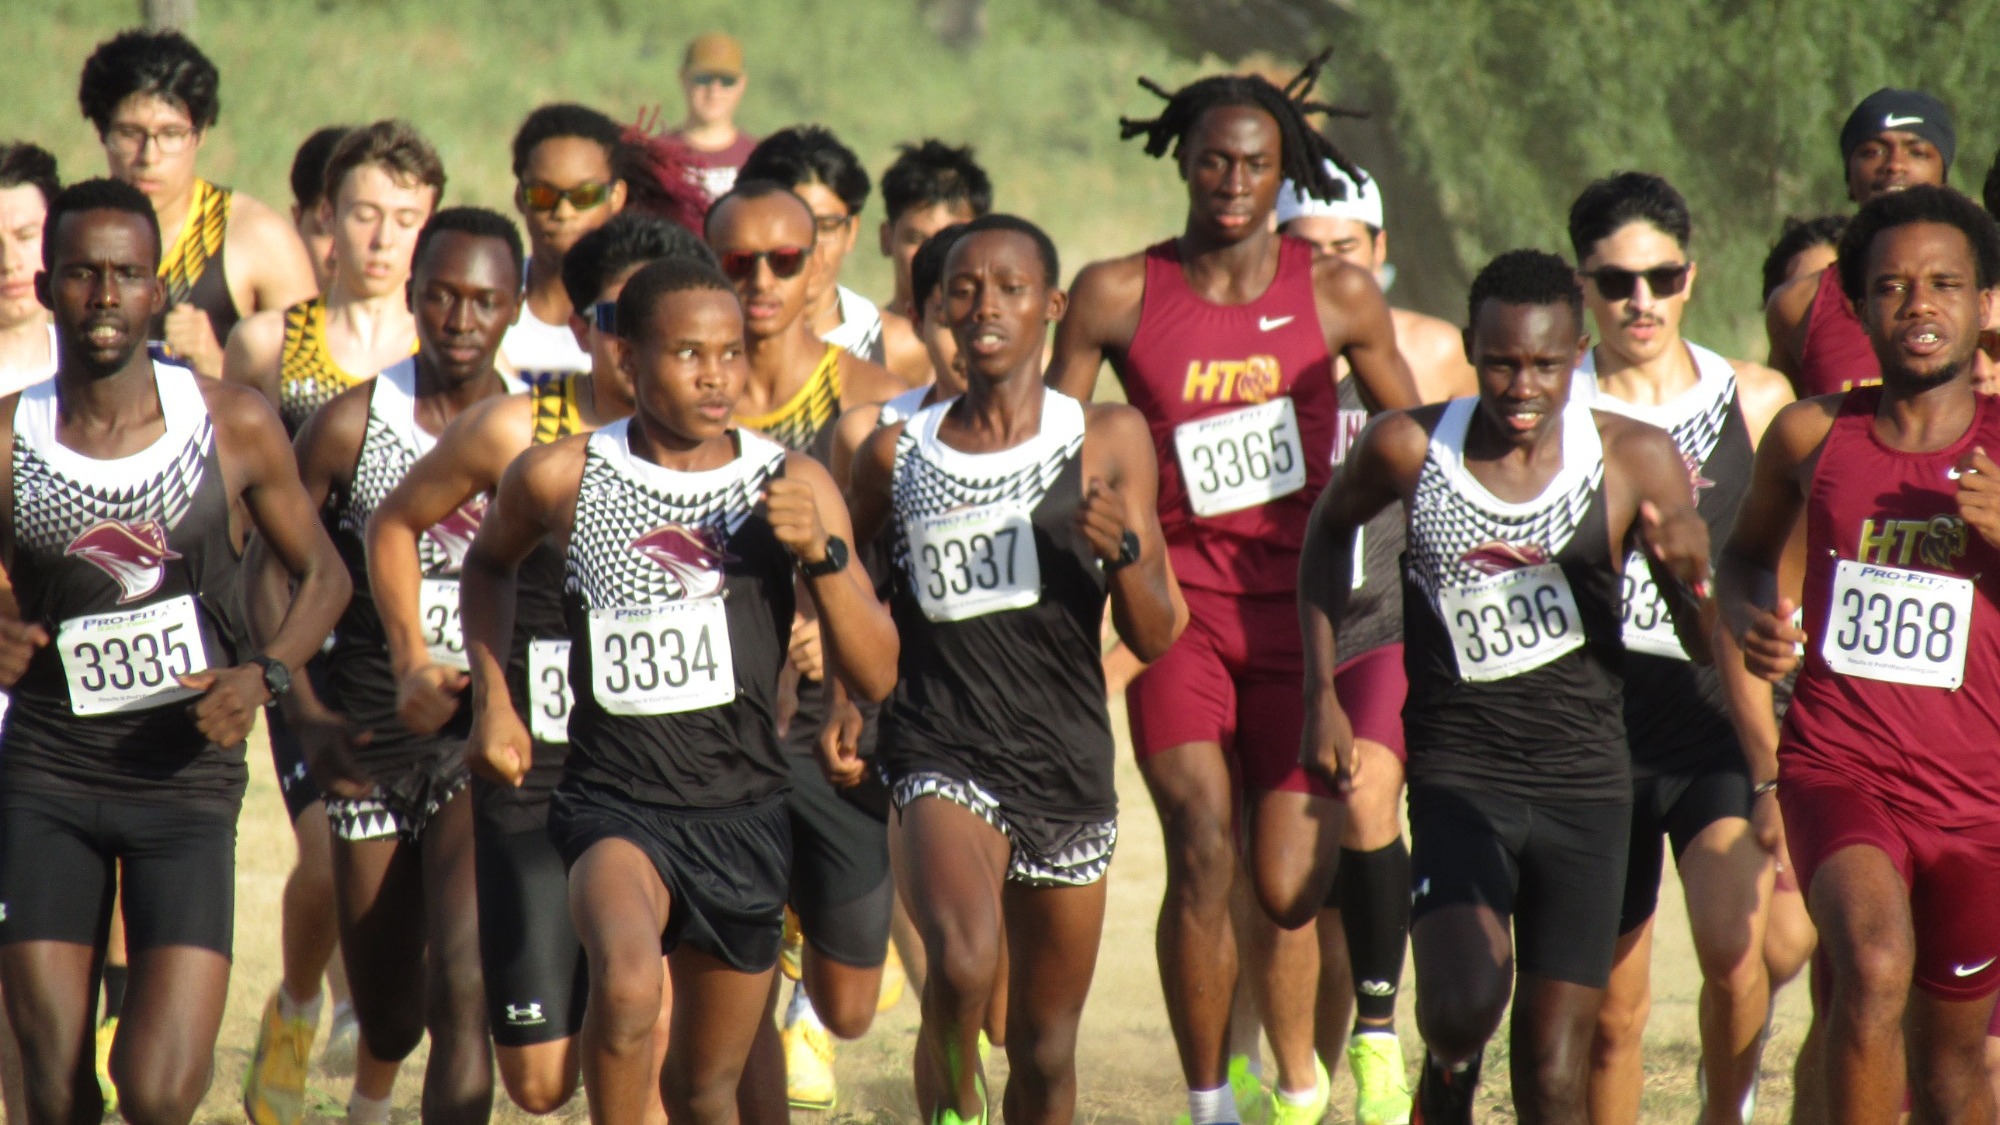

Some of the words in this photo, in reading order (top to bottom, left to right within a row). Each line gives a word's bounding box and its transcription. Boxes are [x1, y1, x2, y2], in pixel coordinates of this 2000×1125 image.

[1192, 422, 1294, 494] 3365
[921, 526, 1019, 600] 3337
[74, 622, 192, 692] 3335
[604, 623, 718, 694] 3334
[1456, 584, 1569, 663] 3336
[1837, 587, 1956, 663] 3368
